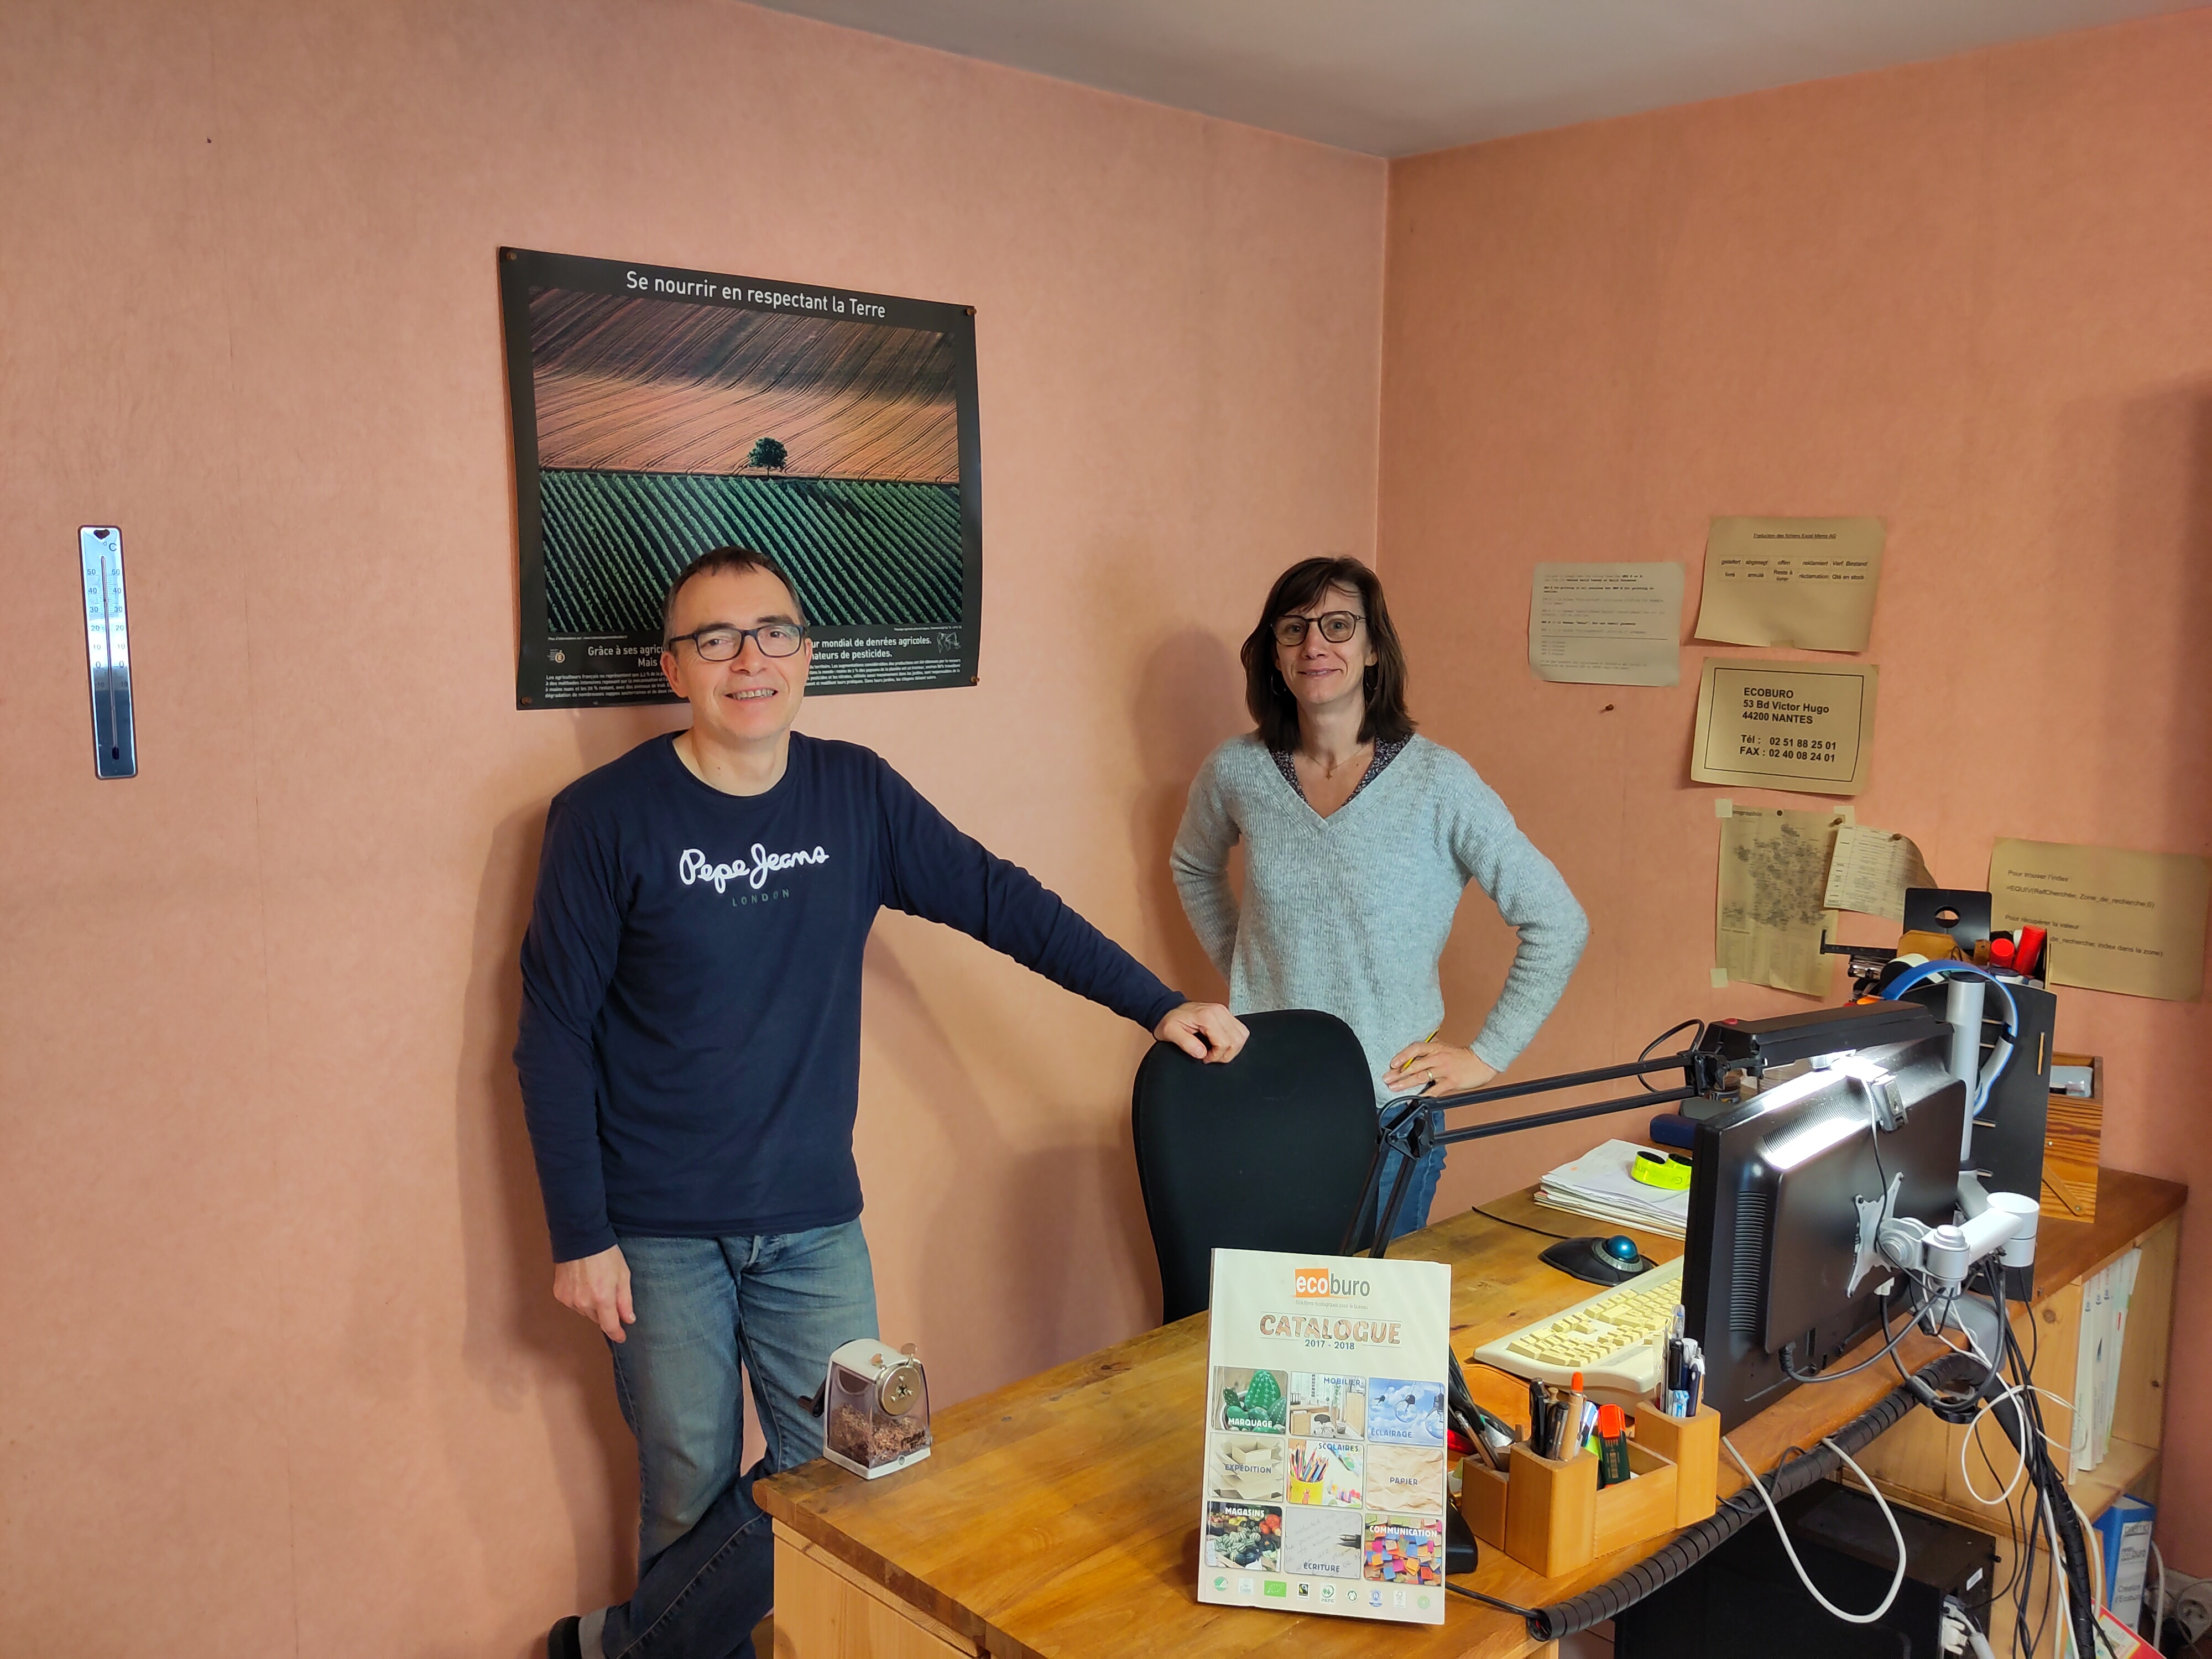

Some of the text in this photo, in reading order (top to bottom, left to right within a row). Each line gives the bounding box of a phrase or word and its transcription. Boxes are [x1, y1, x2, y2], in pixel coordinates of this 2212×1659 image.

[626, 271, 885, 318] Se nourrir en respectant la Terre
[822, 638, 853, 648] mondial
[854, 637, 864, 647] de
[866, 637, 896, 646] denrées
[898, 636, 932, 646] agricoles.
[588, 645, 614, 656] Grâce
[615, 645, 621, 655] à
[623, 646, 638, 655] ses
[841, 649, 850, 659] de
[852, 649, 893, 661] pesticides.
[638, 658, 658, 667] Mais
[1744, 687, 1794, 698] ECOBURO
[1743, 700, 1829, 714] 53 Bd Victor Hugo
[1742, 711, 1813, 724] 44200 NANTES
[1741, 734, 1755, 744] Tél
[1770, 737, 1781, 746] 02
[1783, 738, 1794, 747] 51
[1797, 739, 1808, 748] 88
[1811, 740, 1823, 749] 25
[1825, 741, 1837, 750] 01
[1740, 746, 1760, 756] FAX
[1768, 749, 1780, 758] 02
[1782, 750, 1793, 759] 40
[1796, 751, 1808, 760] 08
[1810, 752, 1822, 761] 24
[1824, 753, 1835, 763] 01
[679, 843, 830, 894] Pepe Jeans
[732, 888, 790, 907] LONDON
[2098, 942, 2116, 951] index
[1296, 1272, 1370, 1297] ecoburo
[1260, 1314, 1401, 1344] CATALOGUE
[1305, 1339, 1326, 1348] 2017
[1334, 1341, 1355, 1350] 2018
[1323, 1376, 1361, 1387] MOBILIER
[1228, 1417, 1272, 1428] MARQUAGE
[1318, 1443, 1359, 1452] SCOLAIRES
[1225, 1463, 1272, 1474] EXPÉDITION
[1390, 1477, 1418, 1485] PAPIER
[1225, 1507, 1265, 1517] MAGASINS
[1369, 1525, 1438, 1537] COMMUNICATION
[1303, 1561, 1340, 1572] ÉCRITURE
